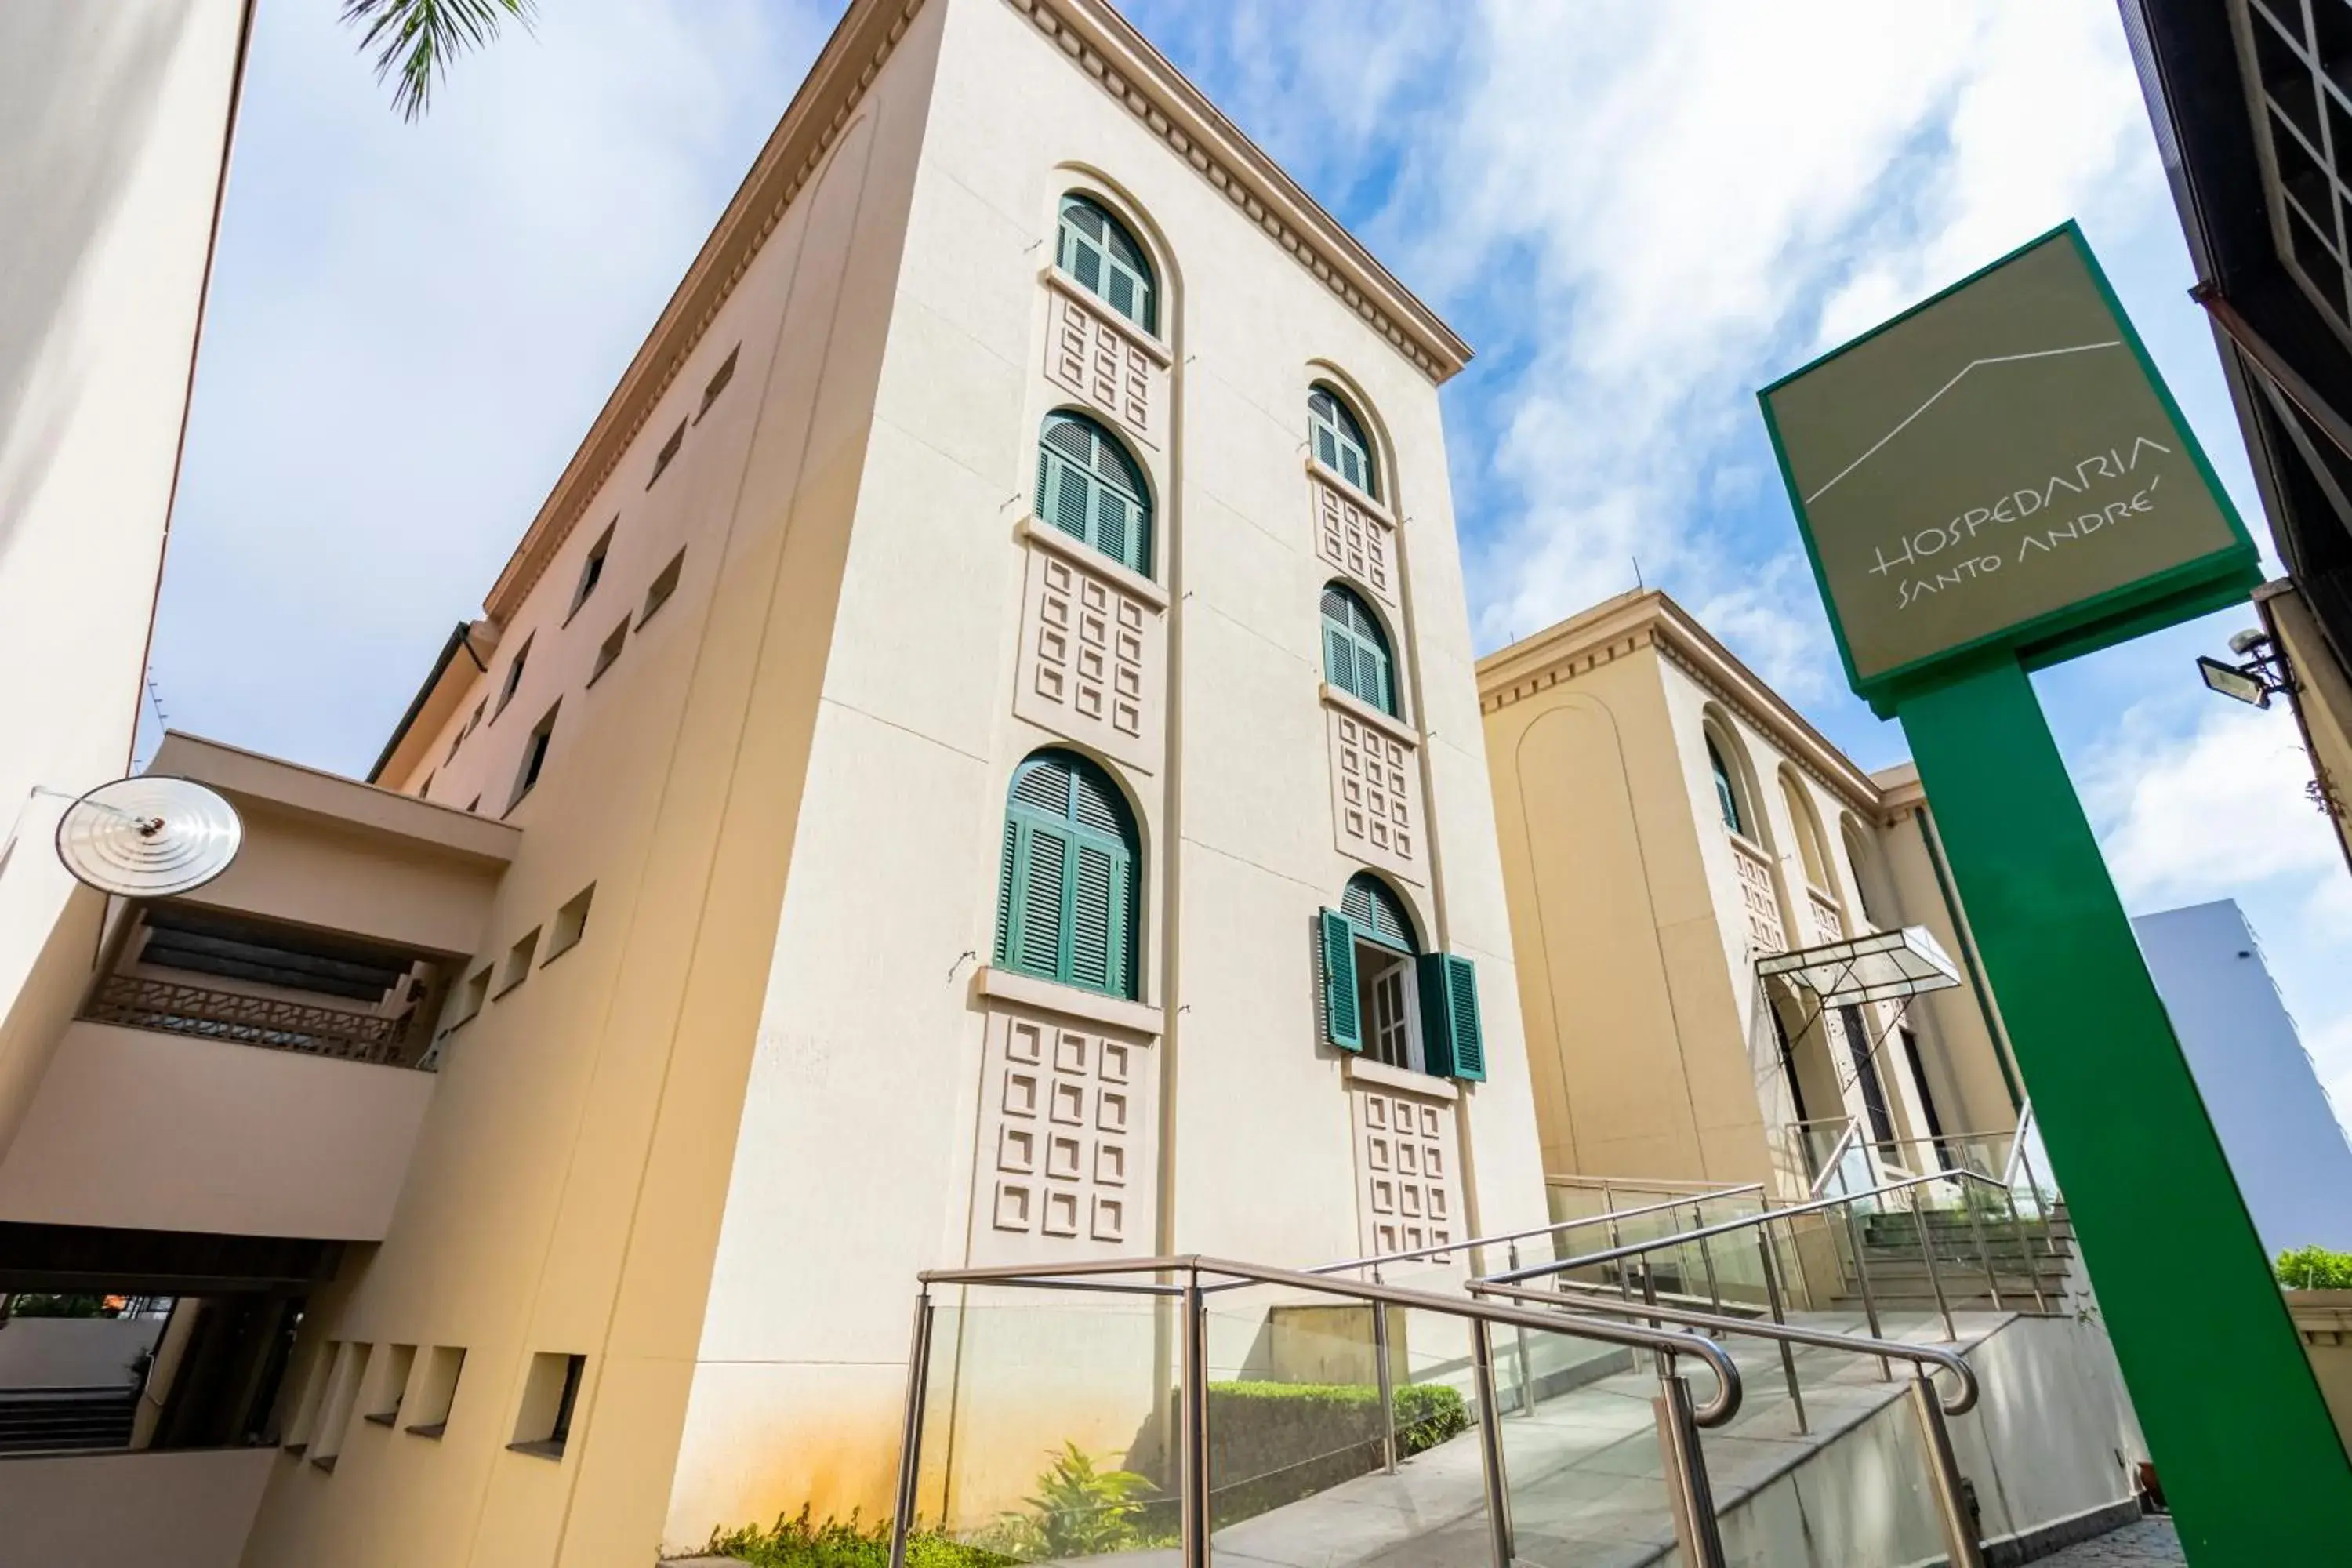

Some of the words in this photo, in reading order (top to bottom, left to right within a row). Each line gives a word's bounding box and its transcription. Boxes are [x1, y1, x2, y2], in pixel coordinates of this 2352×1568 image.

[1869, 437, 2170, 575] HOSPEDARIA
[1897, 555, 2001, 609] SANTO
[2019, 475, 2159, 562] ANDRÉ
